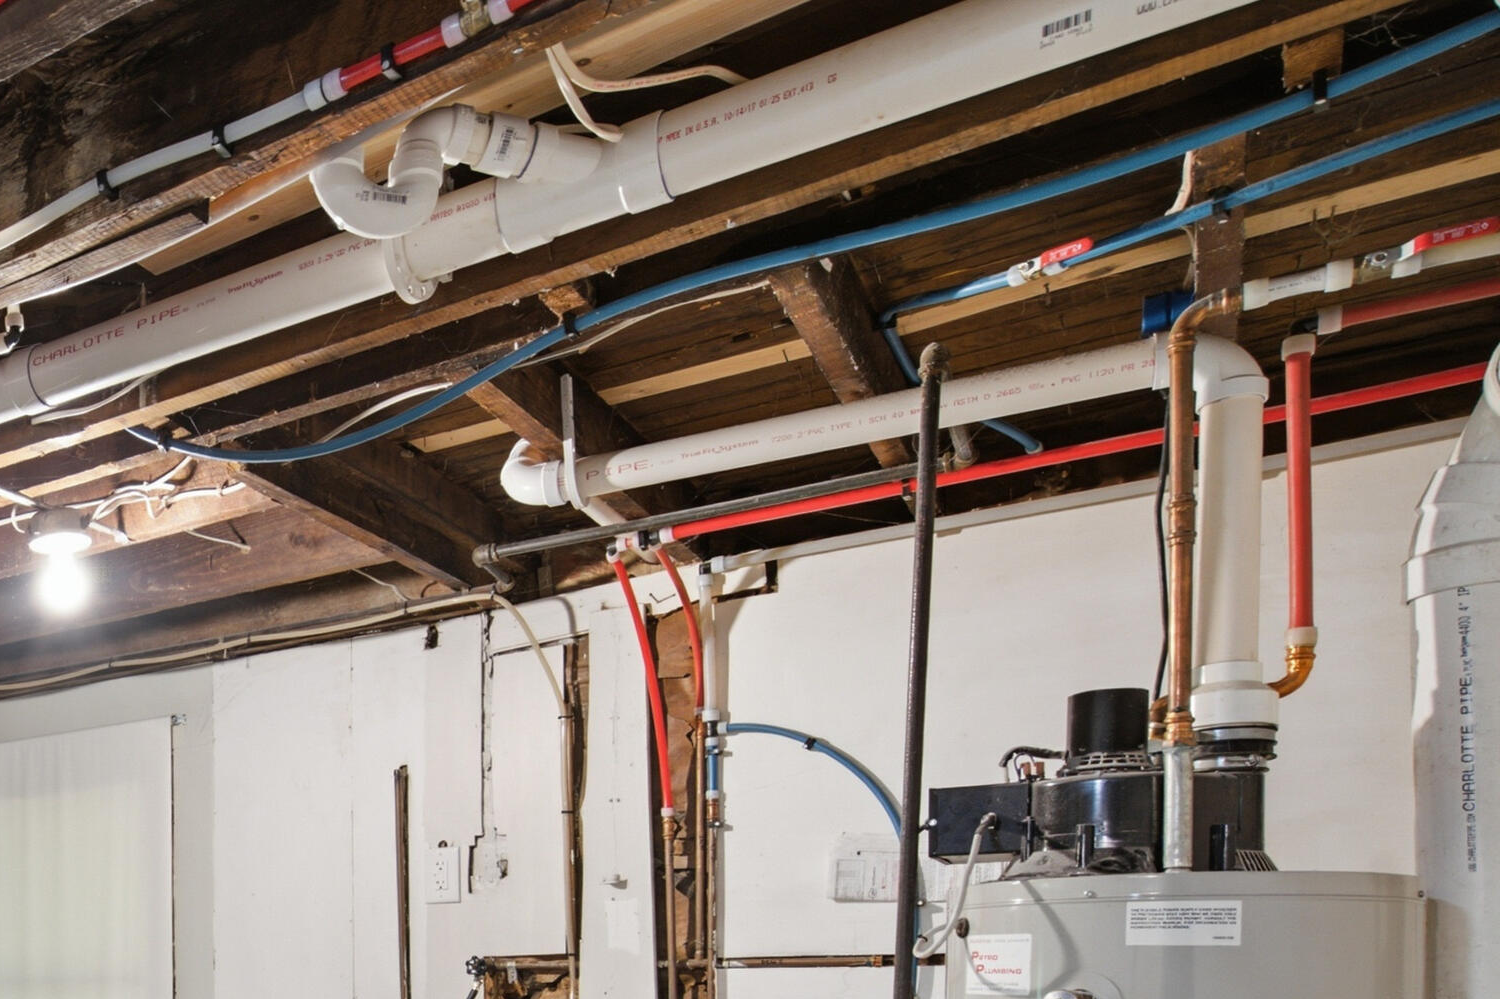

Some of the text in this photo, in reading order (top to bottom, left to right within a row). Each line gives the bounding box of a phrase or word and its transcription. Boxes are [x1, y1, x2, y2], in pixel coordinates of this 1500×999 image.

[32, 326, 125, 367] CHARLOTTE
[136, 304, 182, 330] PIPE
[586, 459, 649, 480] PIPE
[1460, 677, 1474, 715] PIPE
[1461, 725, 1476, 812] CHARLOTTE
